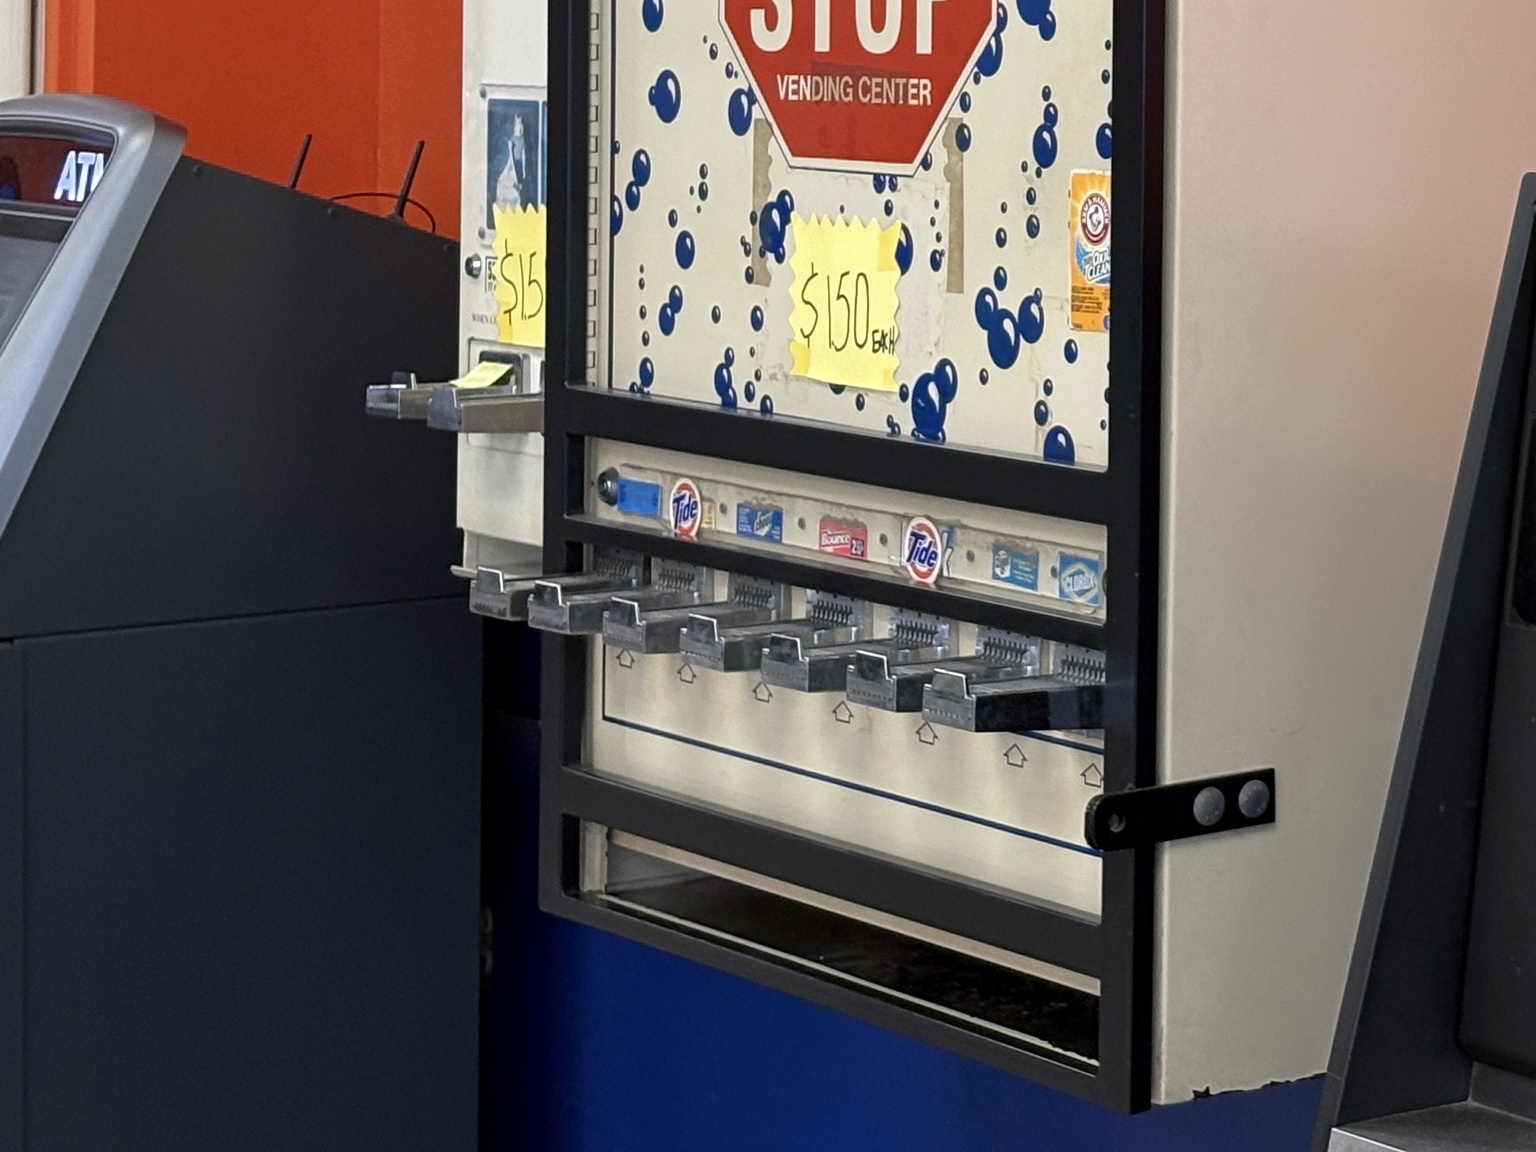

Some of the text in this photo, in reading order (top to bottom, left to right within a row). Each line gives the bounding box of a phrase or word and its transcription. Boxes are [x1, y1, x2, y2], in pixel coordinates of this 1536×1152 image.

[776, 75, 932, 107] VENDING CENTER
[672, 493, 699, 530] Tide
[821, 533, 851, 546] Bounce
[906, 530, 939, 568] Tide
